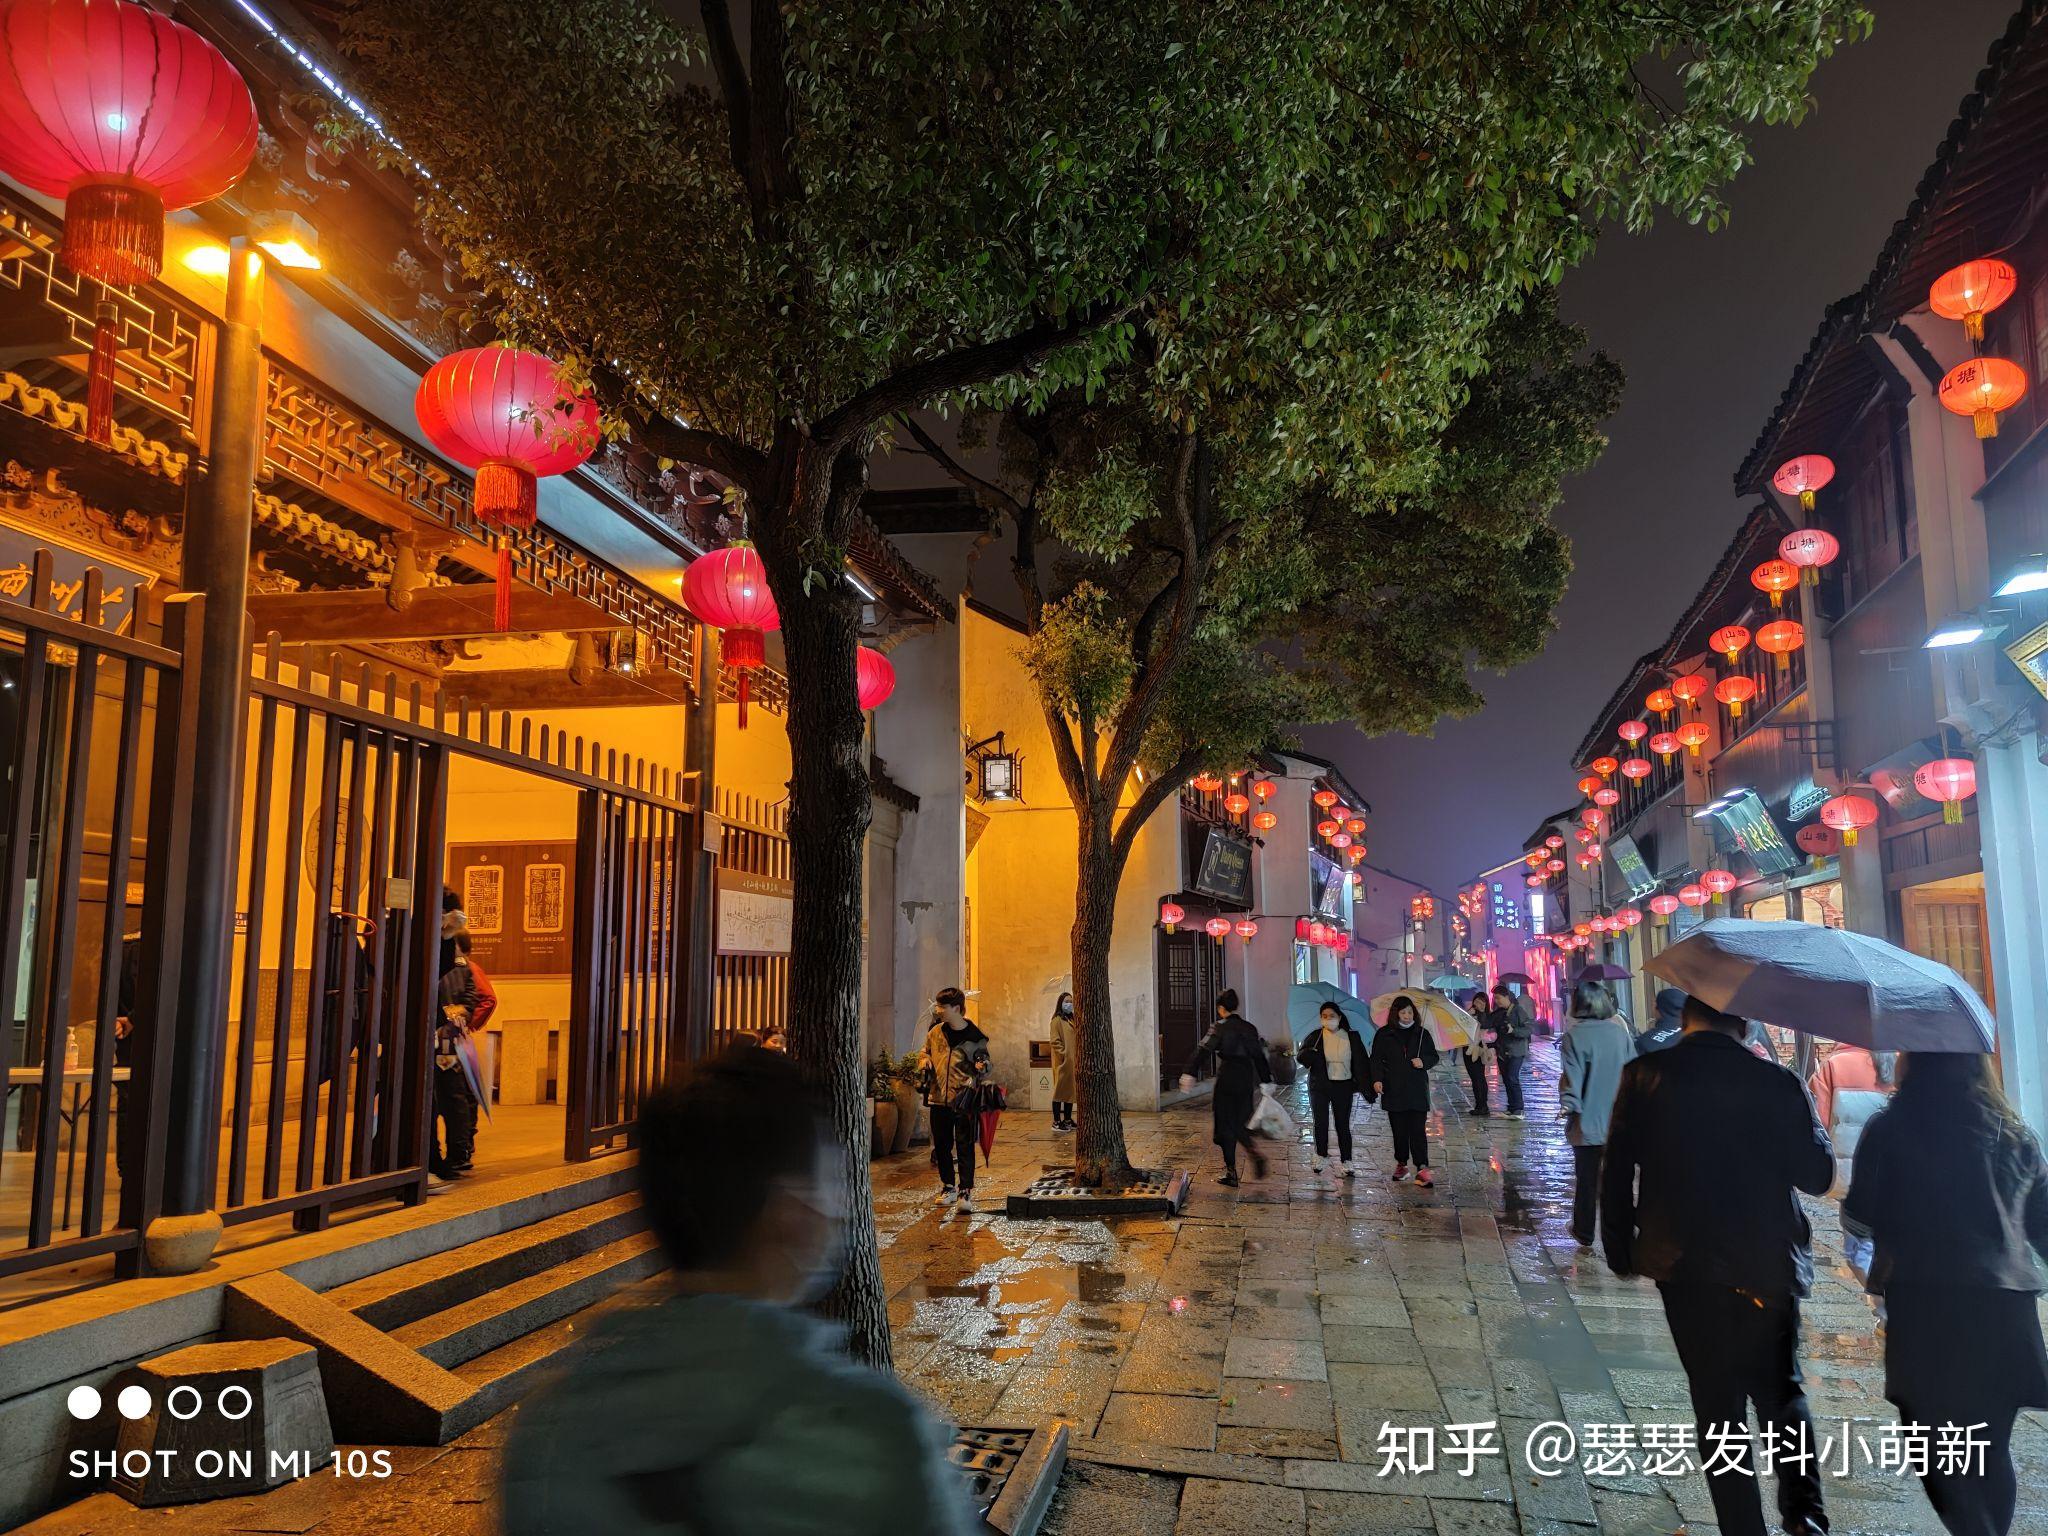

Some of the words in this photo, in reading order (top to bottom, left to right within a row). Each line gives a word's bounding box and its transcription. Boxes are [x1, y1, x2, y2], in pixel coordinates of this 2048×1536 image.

[1941, 366, 1976, 393] 山塘
[1776, 464, 1801, 482] 山塘
[1785, 537, 1815, 551] 山塘
[1759, 566, 1785, 578] 山塘
[1802, 830, 1828, 842] 山塘
